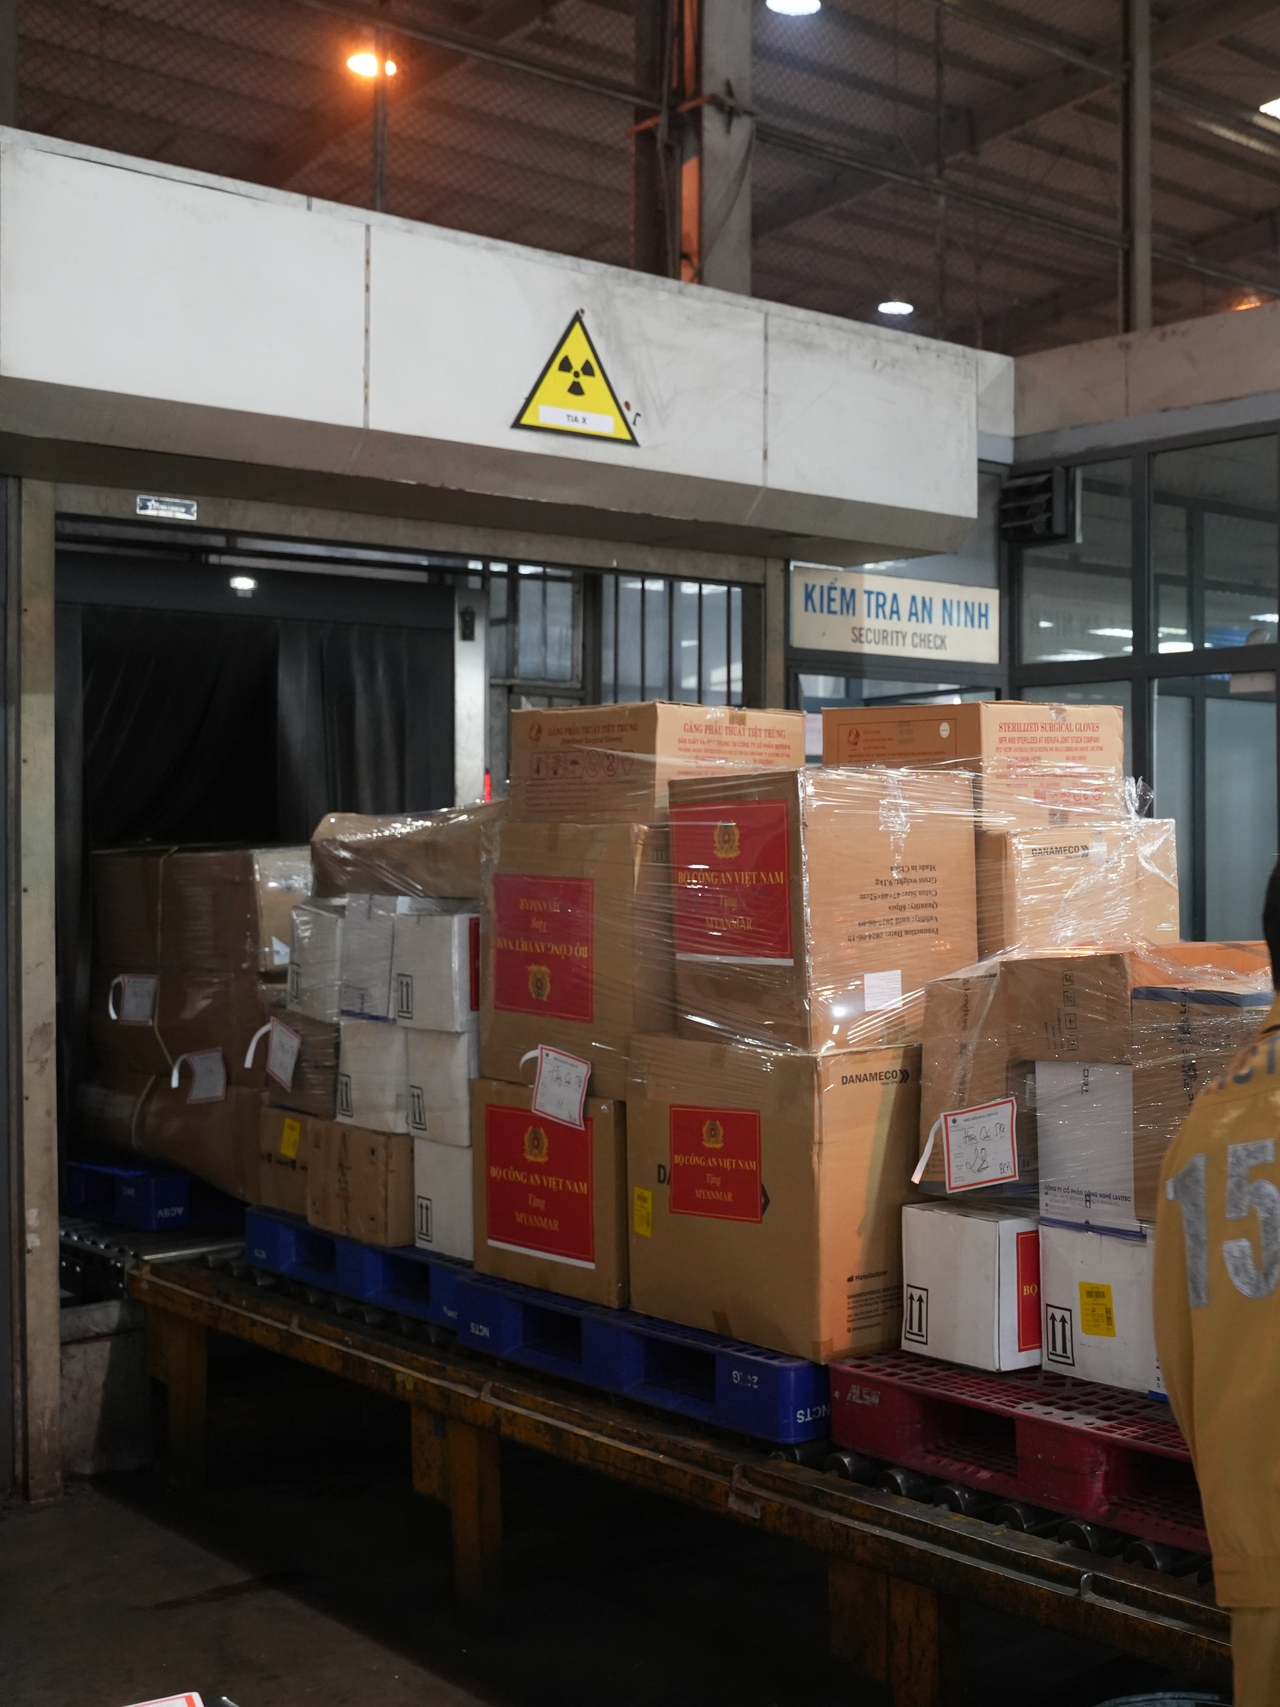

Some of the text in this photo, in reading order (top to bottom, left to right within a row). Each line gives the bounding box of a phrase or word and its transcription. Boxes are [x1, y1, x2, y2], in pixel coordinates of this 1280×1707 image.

[566, 414, 579, 423] TIA
[803, 577, 989, 630] KIỂM TRA AN NINH
[851, 626, 948, 651] SECURITY CHECK
[998, 722, 1100, 733] STERILIZED SURGICAL GLOVES
[1031, 845, 1080, 858] DANAMECO
[691, 868, 718, 885] CÔNG
[720, 872, 732, 884] AN
[734, 869, 757, 888] VIỆT
[760, 871, 784, 885] NAM
[905, 928, 939, 936] Production
[841, 1070, 898, 1086] DANAMECO
[685, 1153, 706, 1167] CÔNG
[707, 1158, 717, 1167] AN
[718, 1158, 736, 1171] VIỆT
[738, 1159, 757, 1171] NAM
[503, 1166, 527, 1183] CÔNG
[529, 1174, 541, 1186] AN
[542, 1174, 563, 1192] VIỆT
[565, 1179, 588, 1195] NAM
[695, 1188, 733, 1202] MYANMAR
[515, 1210, 559, 1231] MYANMAR
[1023, 1283, 1038, 1297] BỘ
[796, 1403, 831, 1423] NCTS
